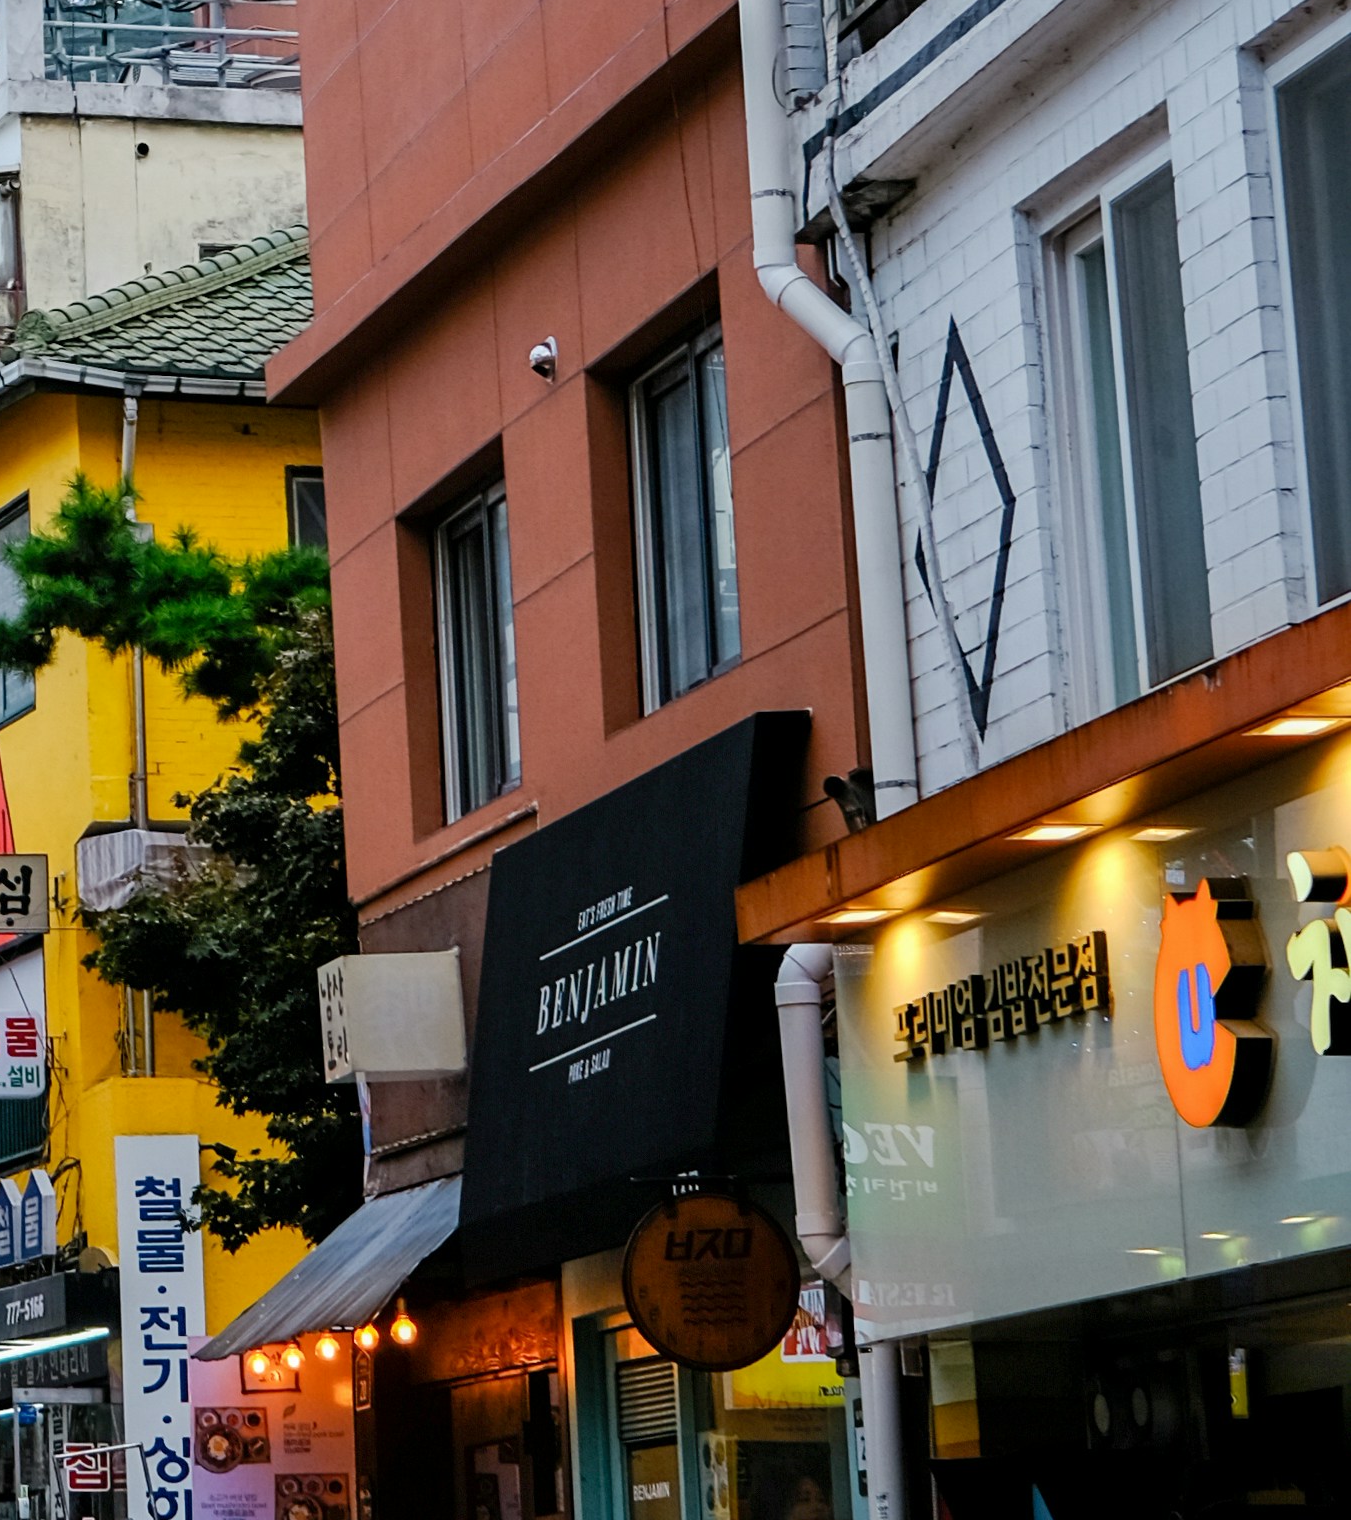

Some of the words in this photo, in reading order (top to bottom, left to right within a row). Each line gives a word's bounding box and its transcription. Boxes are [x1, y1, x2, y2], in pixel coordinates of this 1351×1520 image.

[536, 931, 661, 1035] BENJAMIN
[892, 973, 990, 1063] 프리미엄
[983, 930, 1113, 1042] 김밥전문점
[136, 1175, 189, 1275] 철물
[6, 1294, 44, 1326] 777-5166
[140, 1303, 190, 1403] 전기
[633, 1481, 670, 1501] BENJAMIN
